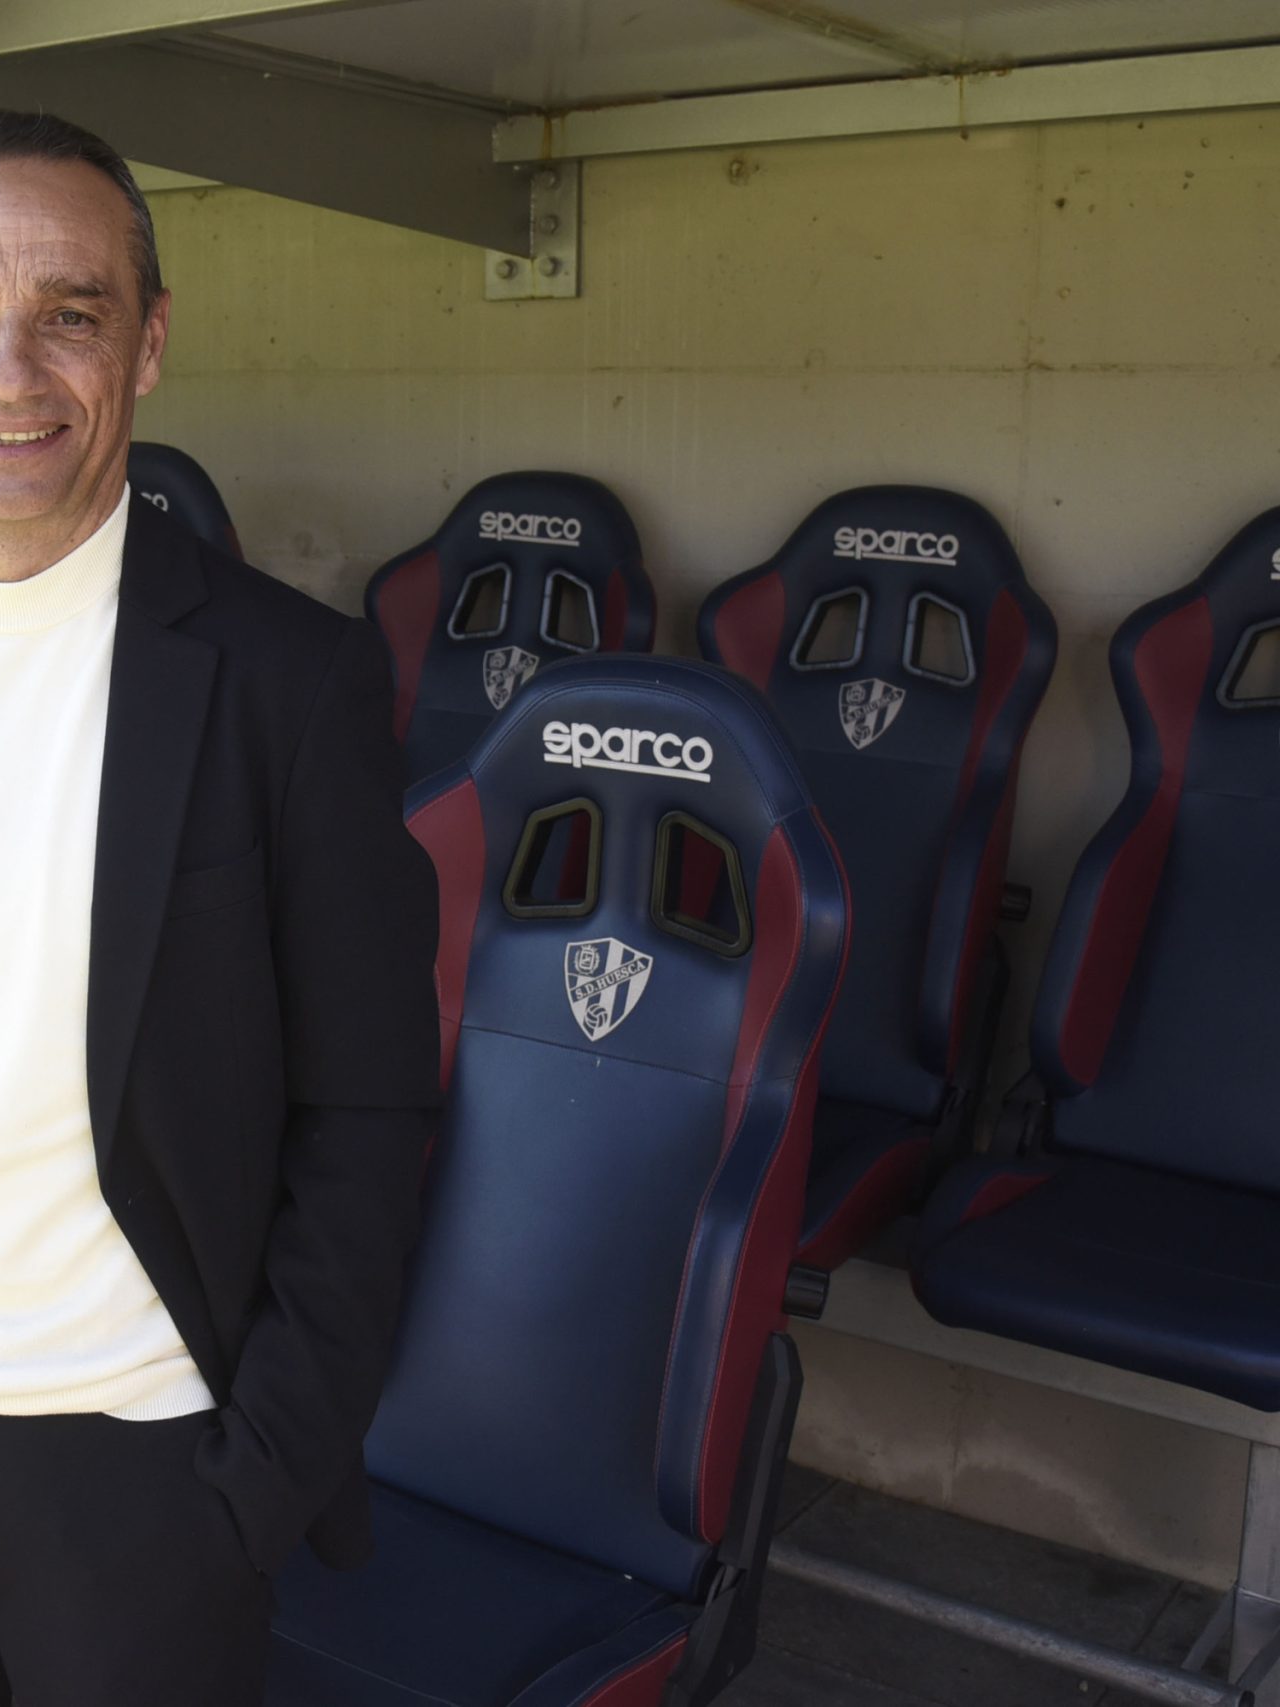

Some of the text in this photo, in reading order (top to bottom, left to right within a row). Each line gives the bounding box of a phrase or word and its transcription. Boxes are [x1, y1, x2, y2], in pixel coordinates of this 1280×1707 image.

[479, 510, 582, 546] sparco
[834, 526, 959, 566] sparco
[542, 720, 713, 783] sparco
